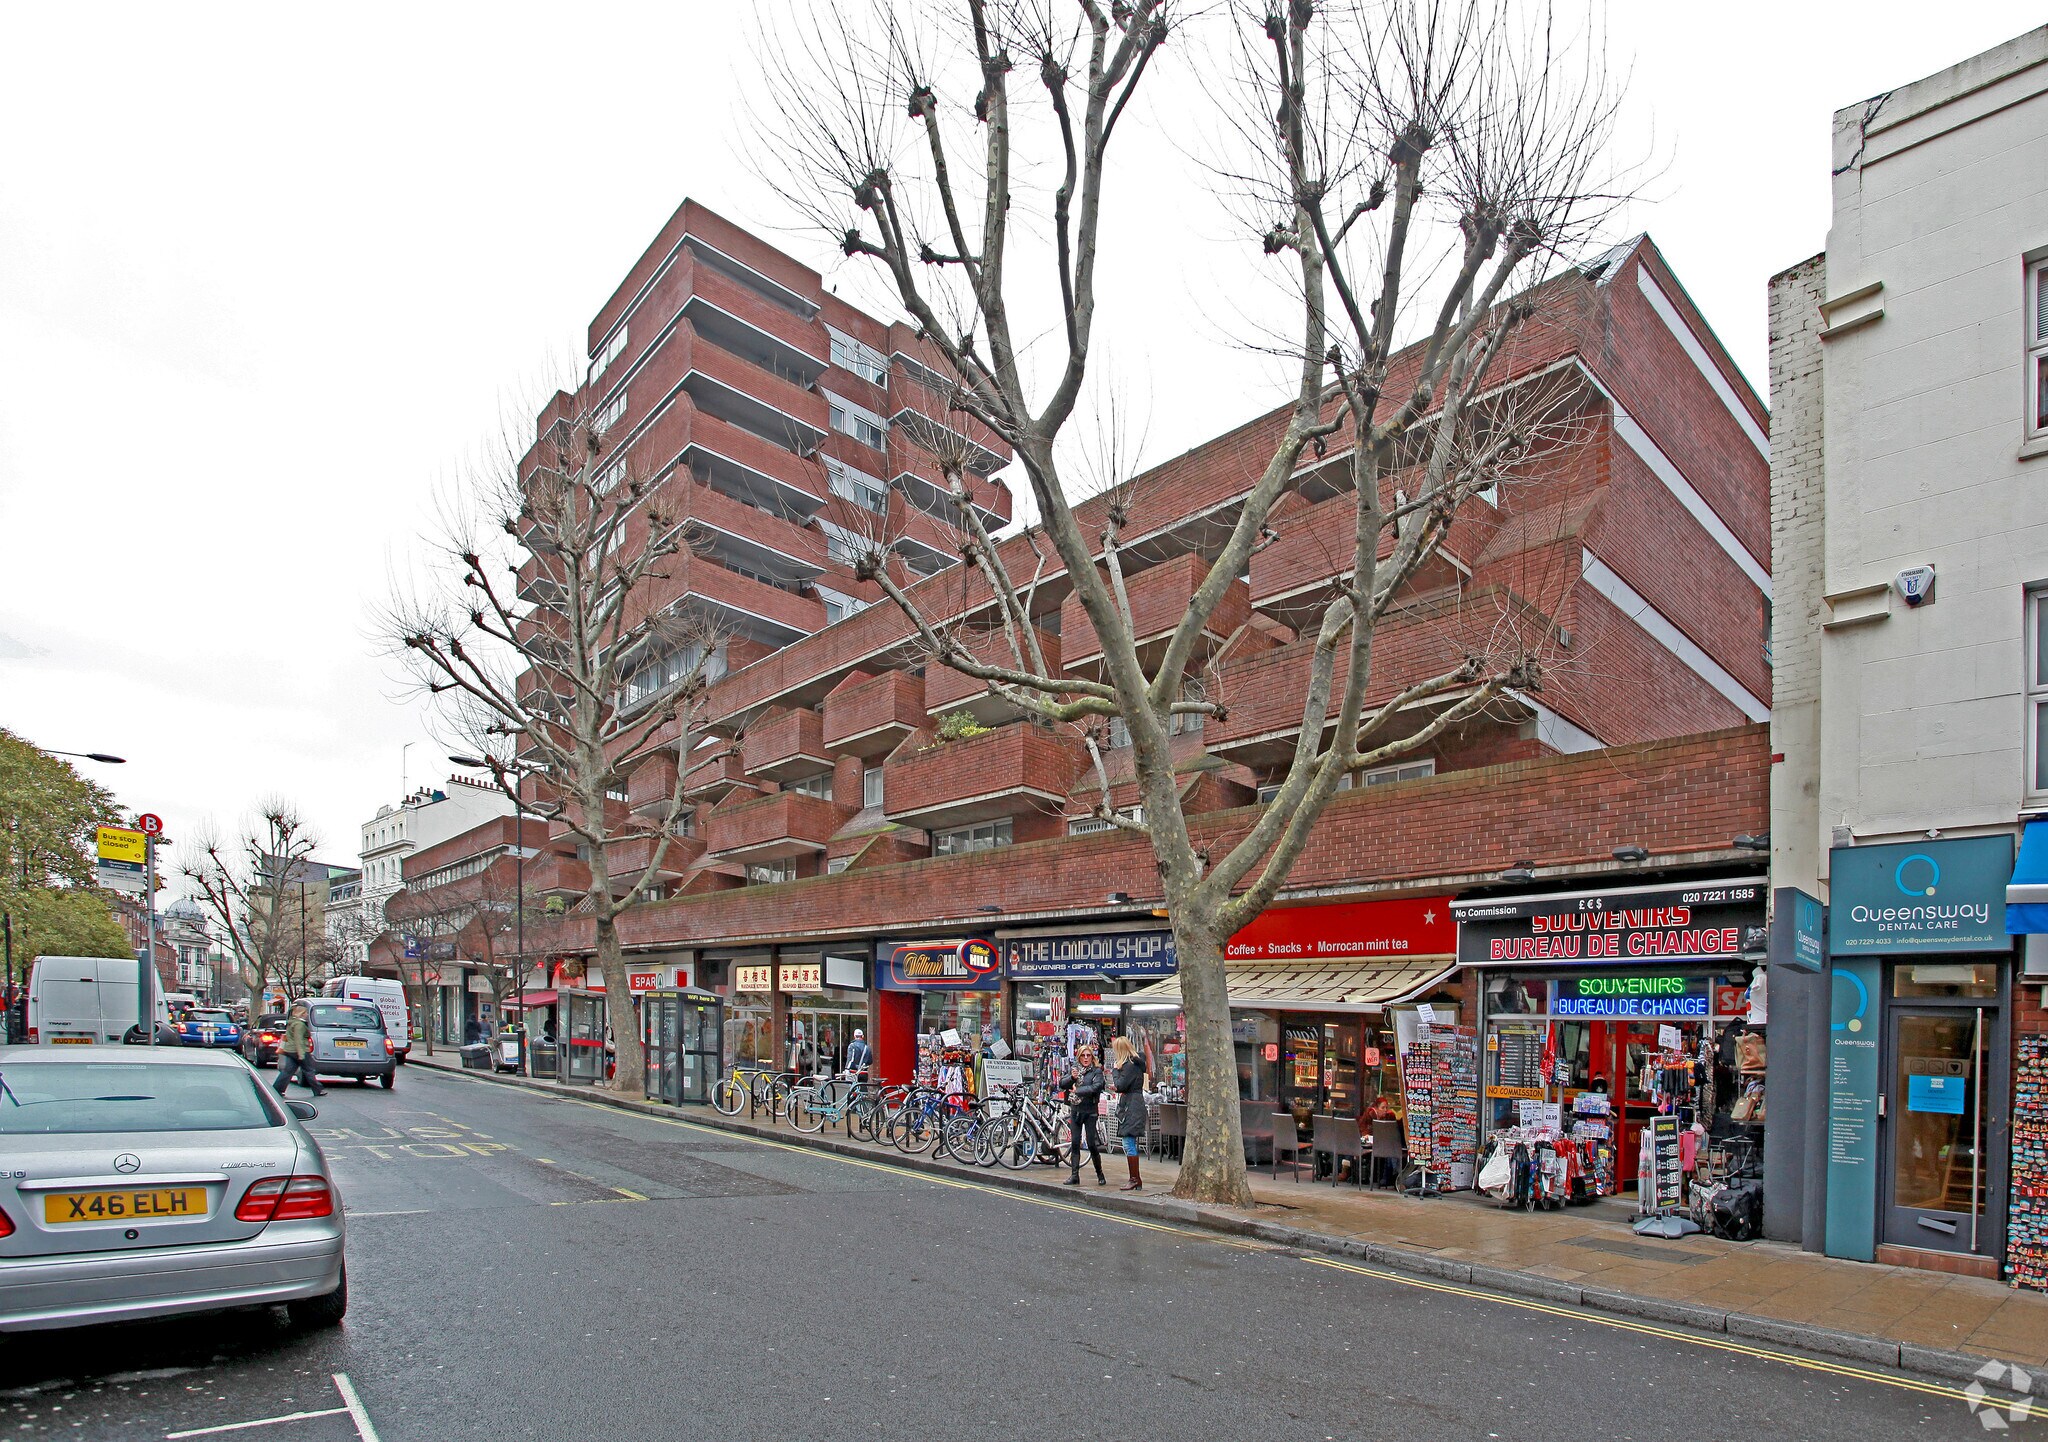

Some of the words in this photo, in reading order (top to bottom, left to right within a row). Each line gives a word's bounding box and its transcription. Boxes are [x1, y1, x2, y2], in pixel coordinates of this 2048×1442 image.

[146, 816, 158, 831] B
[102, 832, 117, 840] Bus
[119, 836, 137, 844] stop
[102, 841, 129, 849] closed
[1682, 893, 1700, 903] 020
[1703, 890, 1726, 901] 7221
[1730, 888, 1755, 900] 1585
[1455, 909, 1466, 918] No
[1468, 906, 1517, 917] Commission
[1532, 906, 1690, 933] SOUVENIRS
[1851, 903, 1989, 924] Queensway
[1878, 921, 1924, 931] DENTAL
[1926, 920, 1958, 930] CARE
[1227, 945, 1256, 955] Coffee
[1268, 942, 1302, 954] Snacks
[1317, 940, 1364, 952] Morrocan
[1366, 938, 1389, 951] mint
[1391, 939, 1408, 950] tea
[1490, 935, 1580, 960] BUREAU
[1587, 933, 1619, 957] DE
[1627, 927, 1738, 956] CHANGE
[1896, 934, 1993, 945] info@queenswaydental.co.uk
[1022, 942, 1049, 962] THE
[1052, 938, 1112, 961] LONDON
[1116, 936, 1162, 959] SHOP
[903, 952, 943, 977] William
[969, 953, 990, 968] HILL
[635, 976, 656, 987] SPAR
[1578, 977, 1685, 995] SOUVENIRS
[1558, 999, 1615, 1015] BUREAU
[1619, 998, 1638, 1015] DE
[1641, 997, 1706, 1015] CHANGE
[1834, 1038, 1875, 1048] Queensway
[1499, 1088, 1543, 1097] COMMISSION
[68, 1194, 125, 1219] X46
[134, 1190, 188, 1215] ELH
